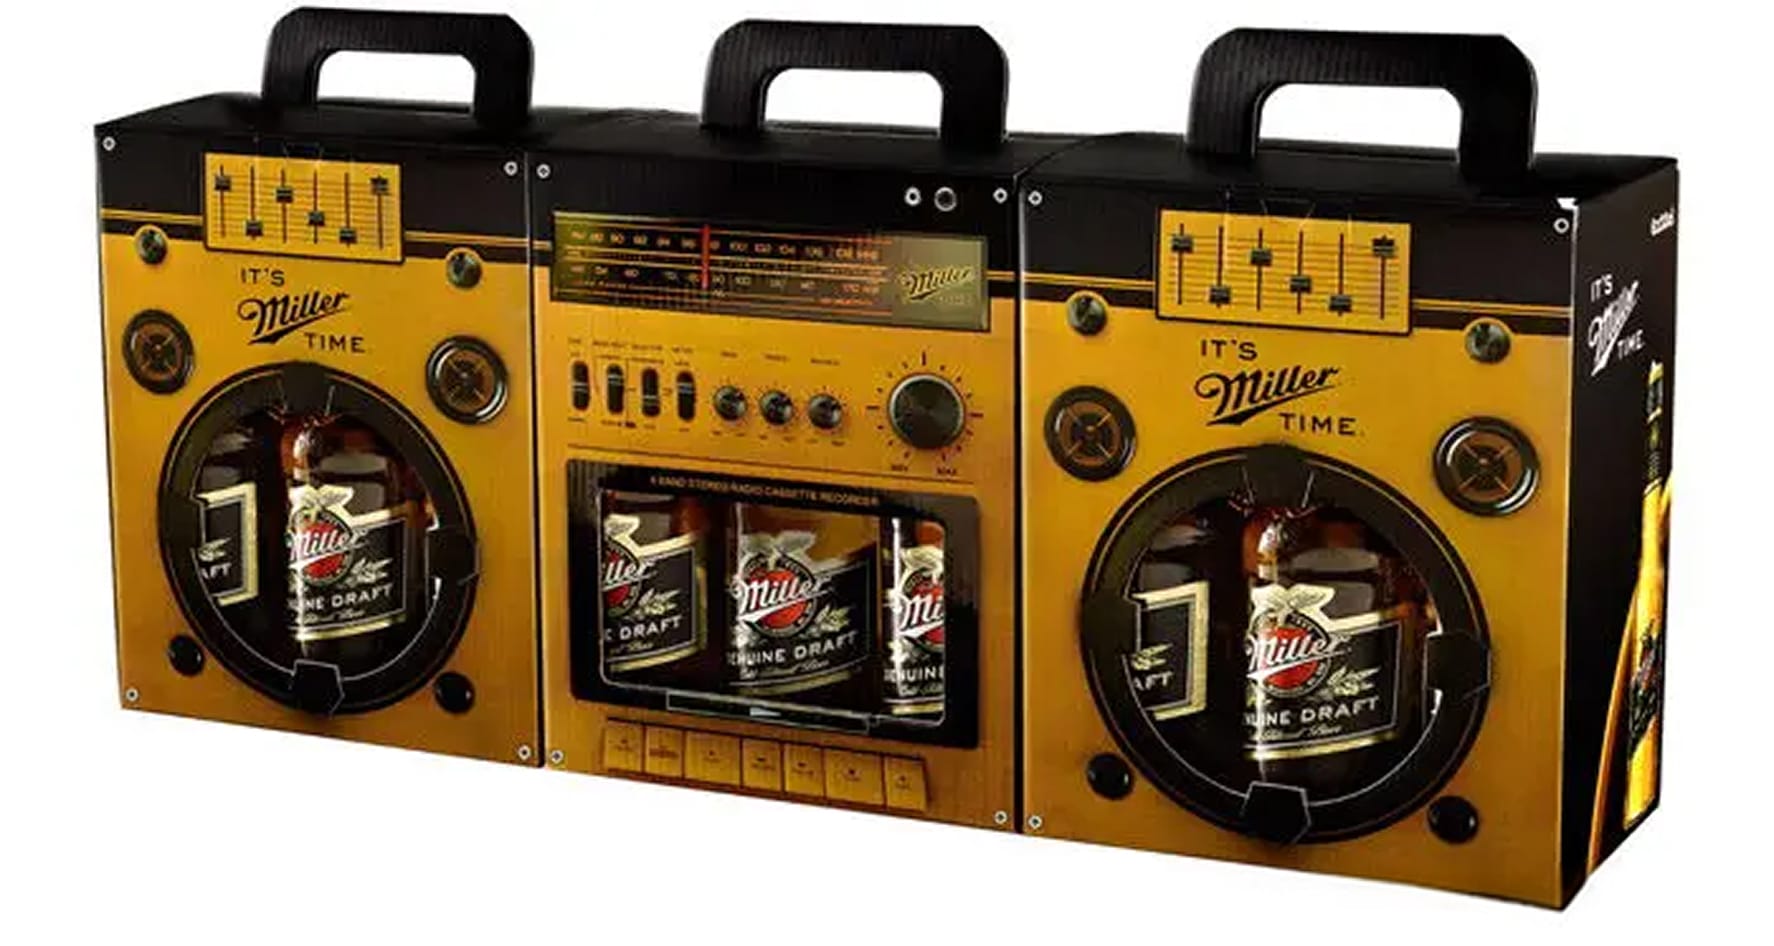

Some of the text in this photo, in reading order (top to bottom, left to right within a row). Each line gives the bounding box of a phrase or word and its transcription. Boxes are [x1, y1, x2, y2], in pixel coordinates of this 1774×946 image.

[241, 267, 286, 287] IT'S
[901, 266, 974, 302] Miller
[1591, 273, 1613, 301] IT'S
[237, 291, 350, 346] Miller
[304, 332, 366, 353] TIME
[1200, 338, 1259, 362] IT'S
[1617, 328, 1644, 360] TIME
[1194, 365, 1343, 427] Miller
[1278, 412, 1356, 436] TIME
[331, 582, 393, 608] DRAFT
[727, 573, 834, 624] Miller
[619, 615, 683, 641] DRAFT
[794, 630, 859, 660] DRAFT
[1246, 631, 1353, 680] Miller
[1301, 696, 1380, 723] DRAFT
